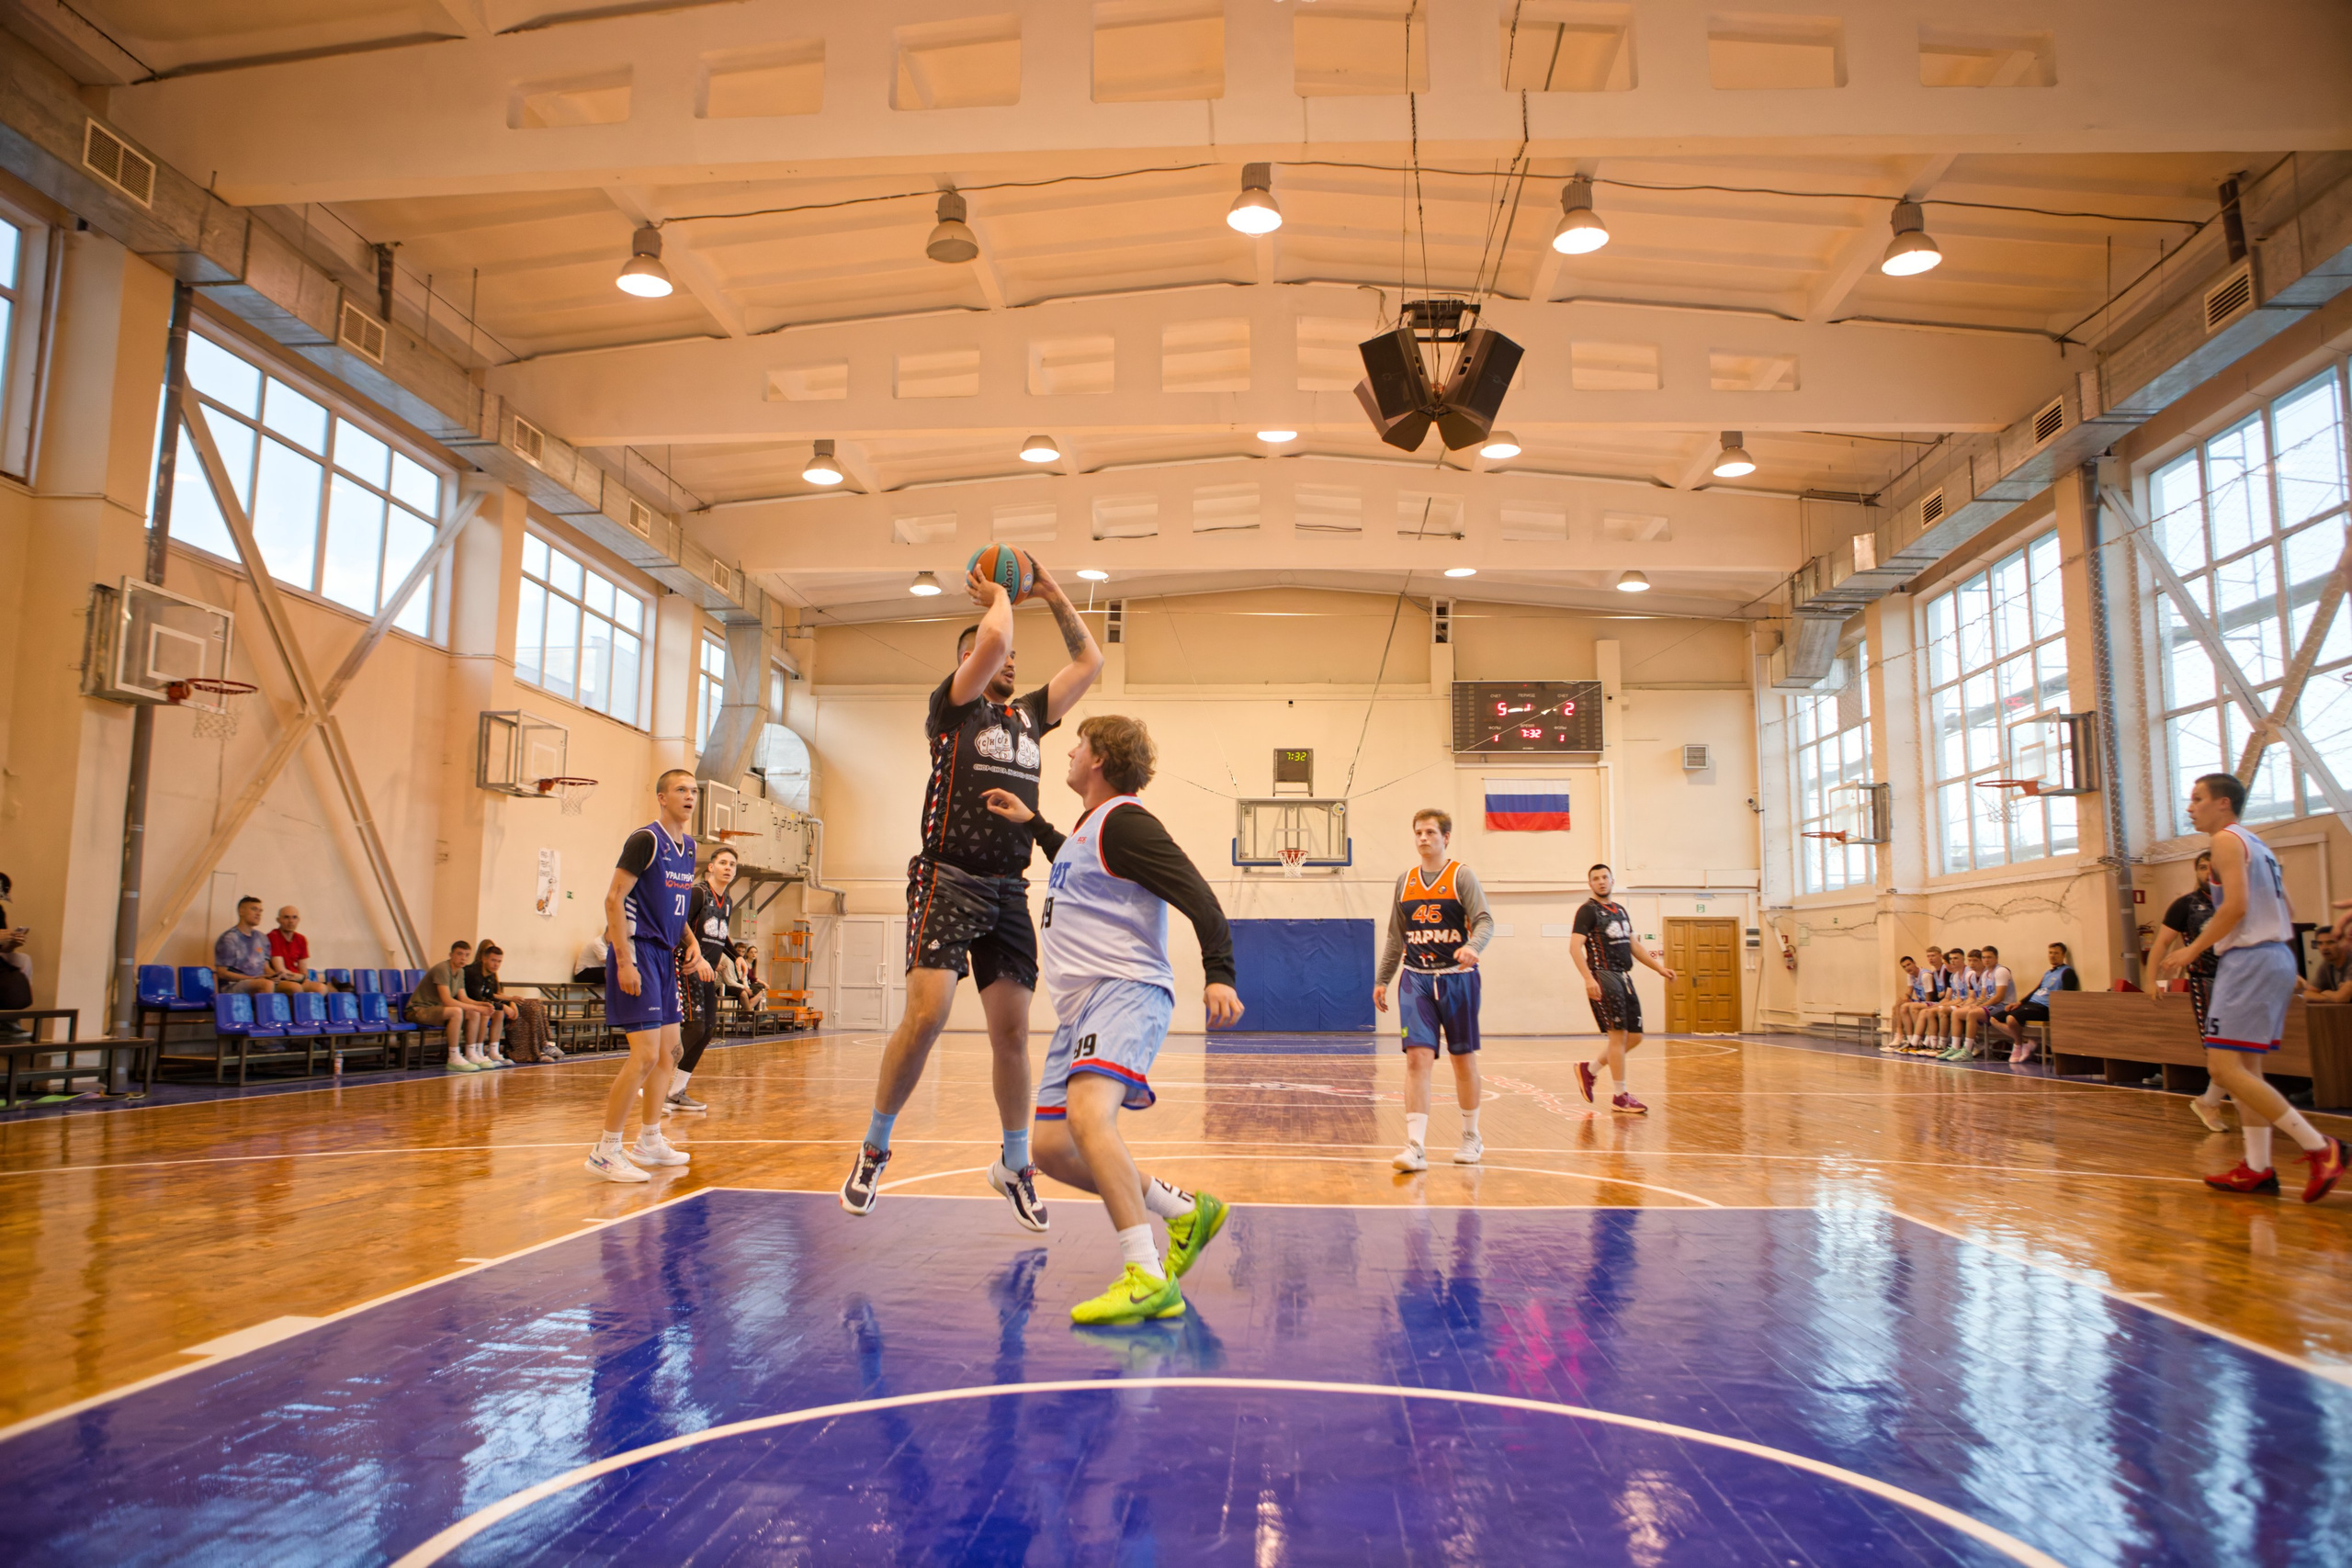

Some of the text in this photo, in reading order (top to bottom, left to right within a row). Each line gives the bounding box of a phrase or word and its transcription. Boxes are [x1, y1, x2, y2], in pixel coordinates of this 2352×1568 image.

[1497, 702, 1507, 716] 5
[1564, 702, 1575, 716] 2
[1521, 728, 1542, 739] 7:32
[1286, 751, 1306, 761] 7:32
[674, 894, 685, 917] 21
[1411, 904, 1442, 924] 46
